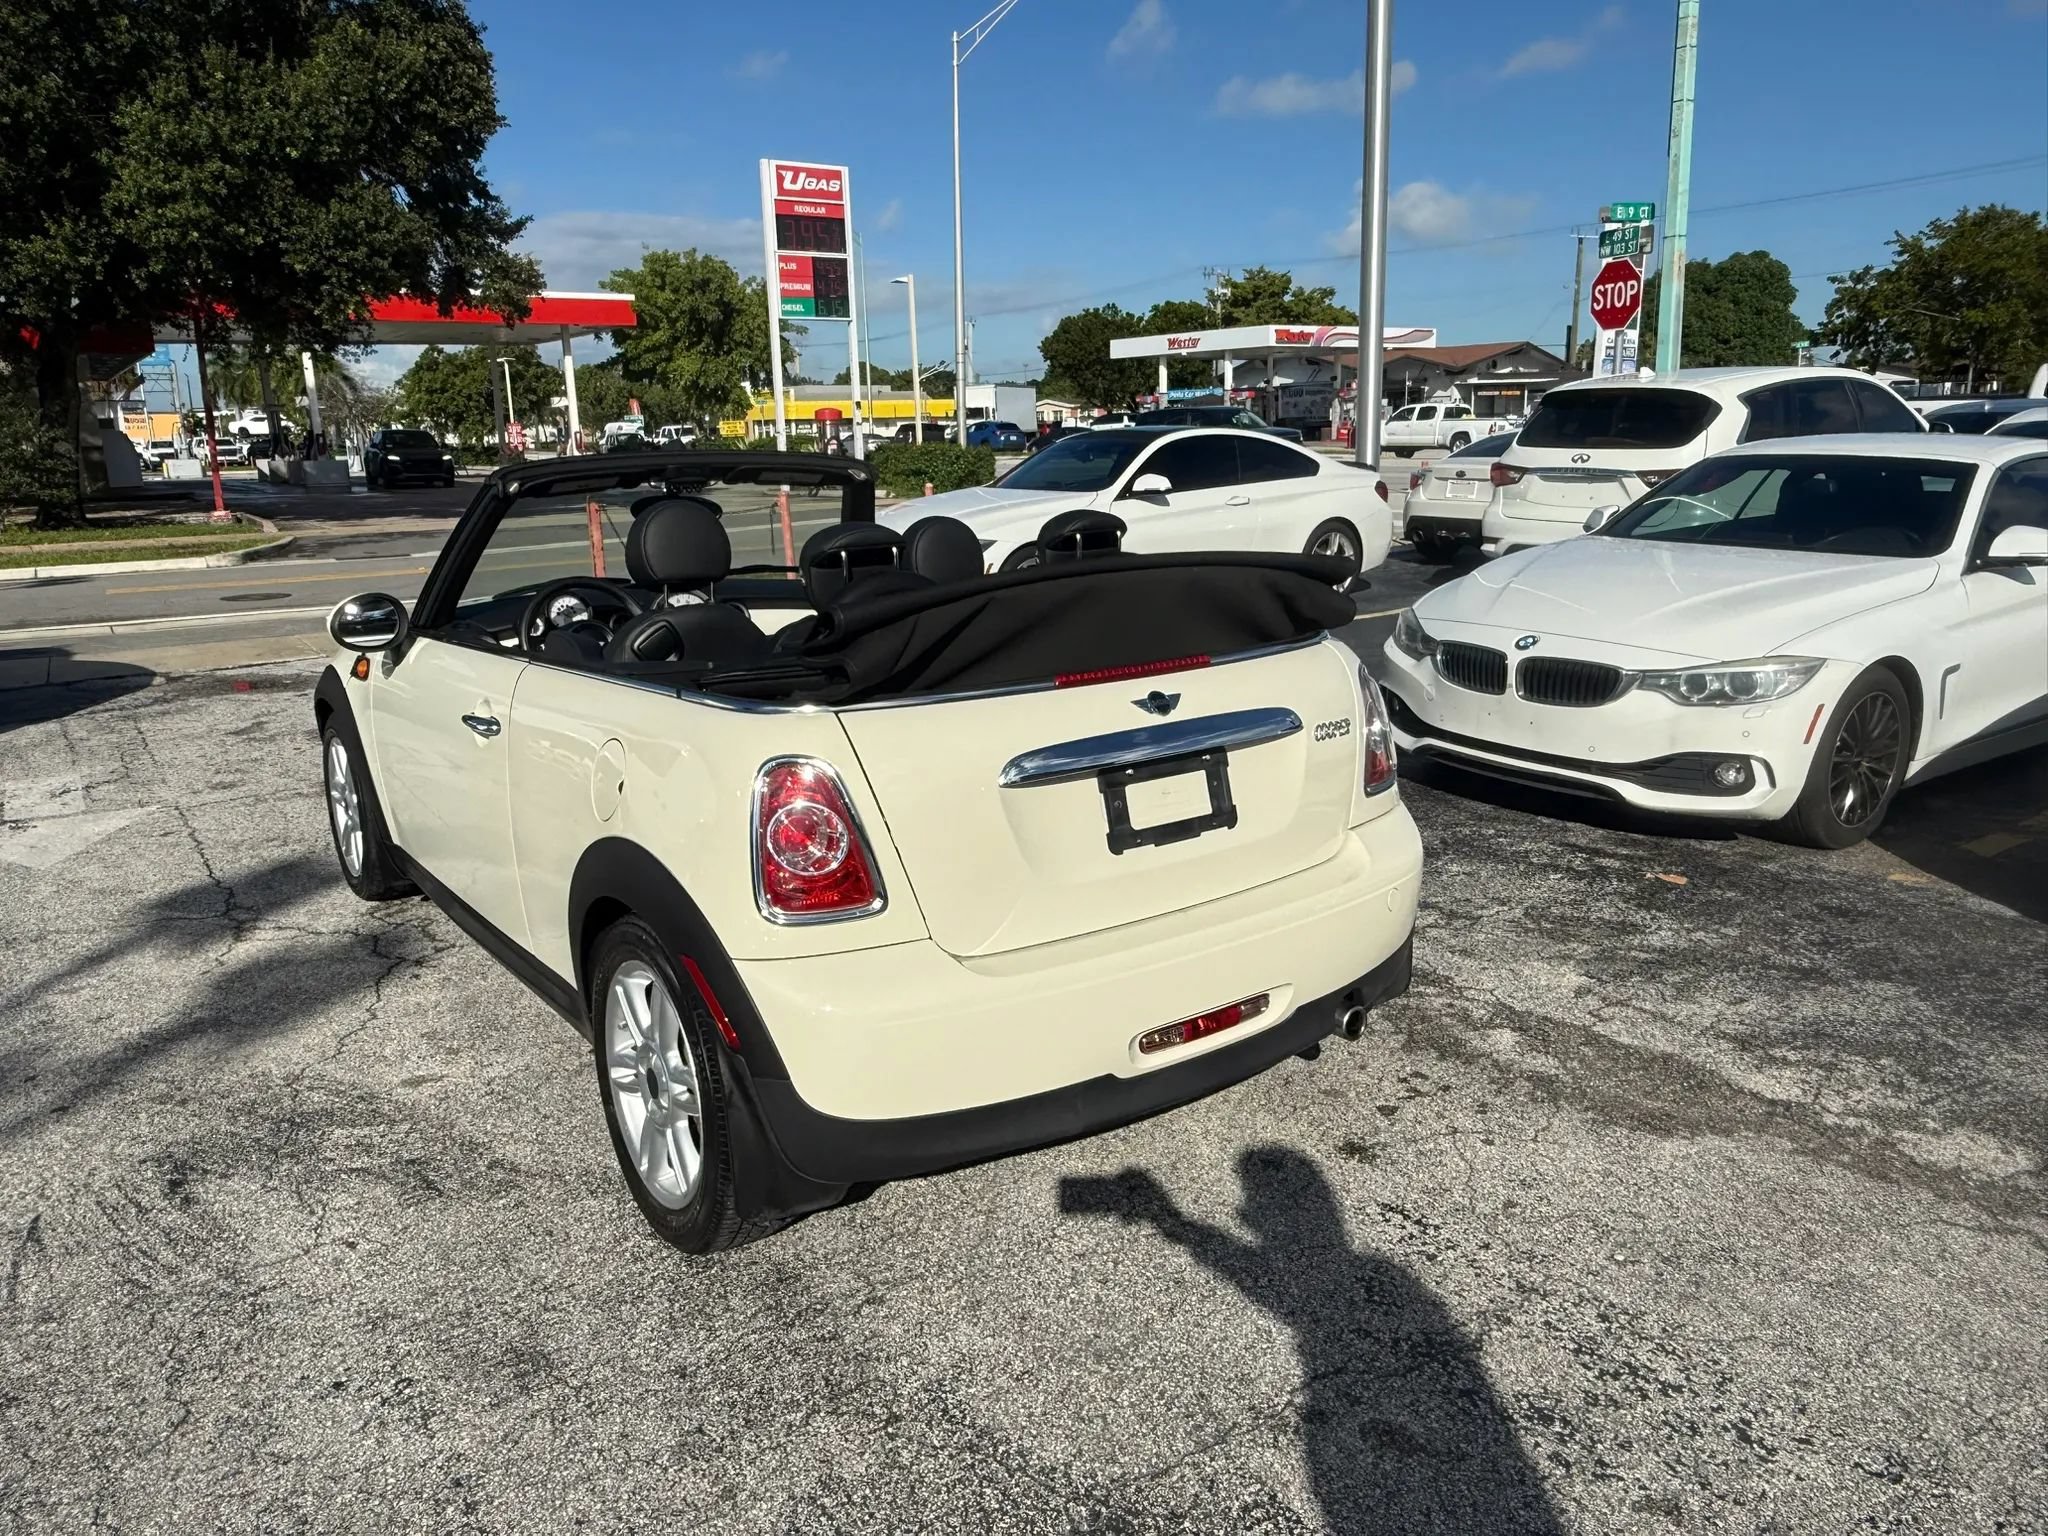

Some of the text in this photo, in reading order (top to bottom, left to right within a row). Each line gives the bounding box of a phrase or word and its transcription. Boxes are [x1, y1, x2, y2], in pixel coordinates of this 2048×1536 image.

[794, 204, 826, 214] REGULAR
[1628, 206, 1634, 217] 9
[1639, 206, 1649, 218] CT
[1612, 230, 1622, 241] 49
[1624, 227, 1634, 240] ST
[1601, 239, 1638, 257] NW 103 ST
[779, 262, 797, 270] PLUS
[1592, 279, 1638, 311] STOP
[781, 303, 805, 312] DIESEL
